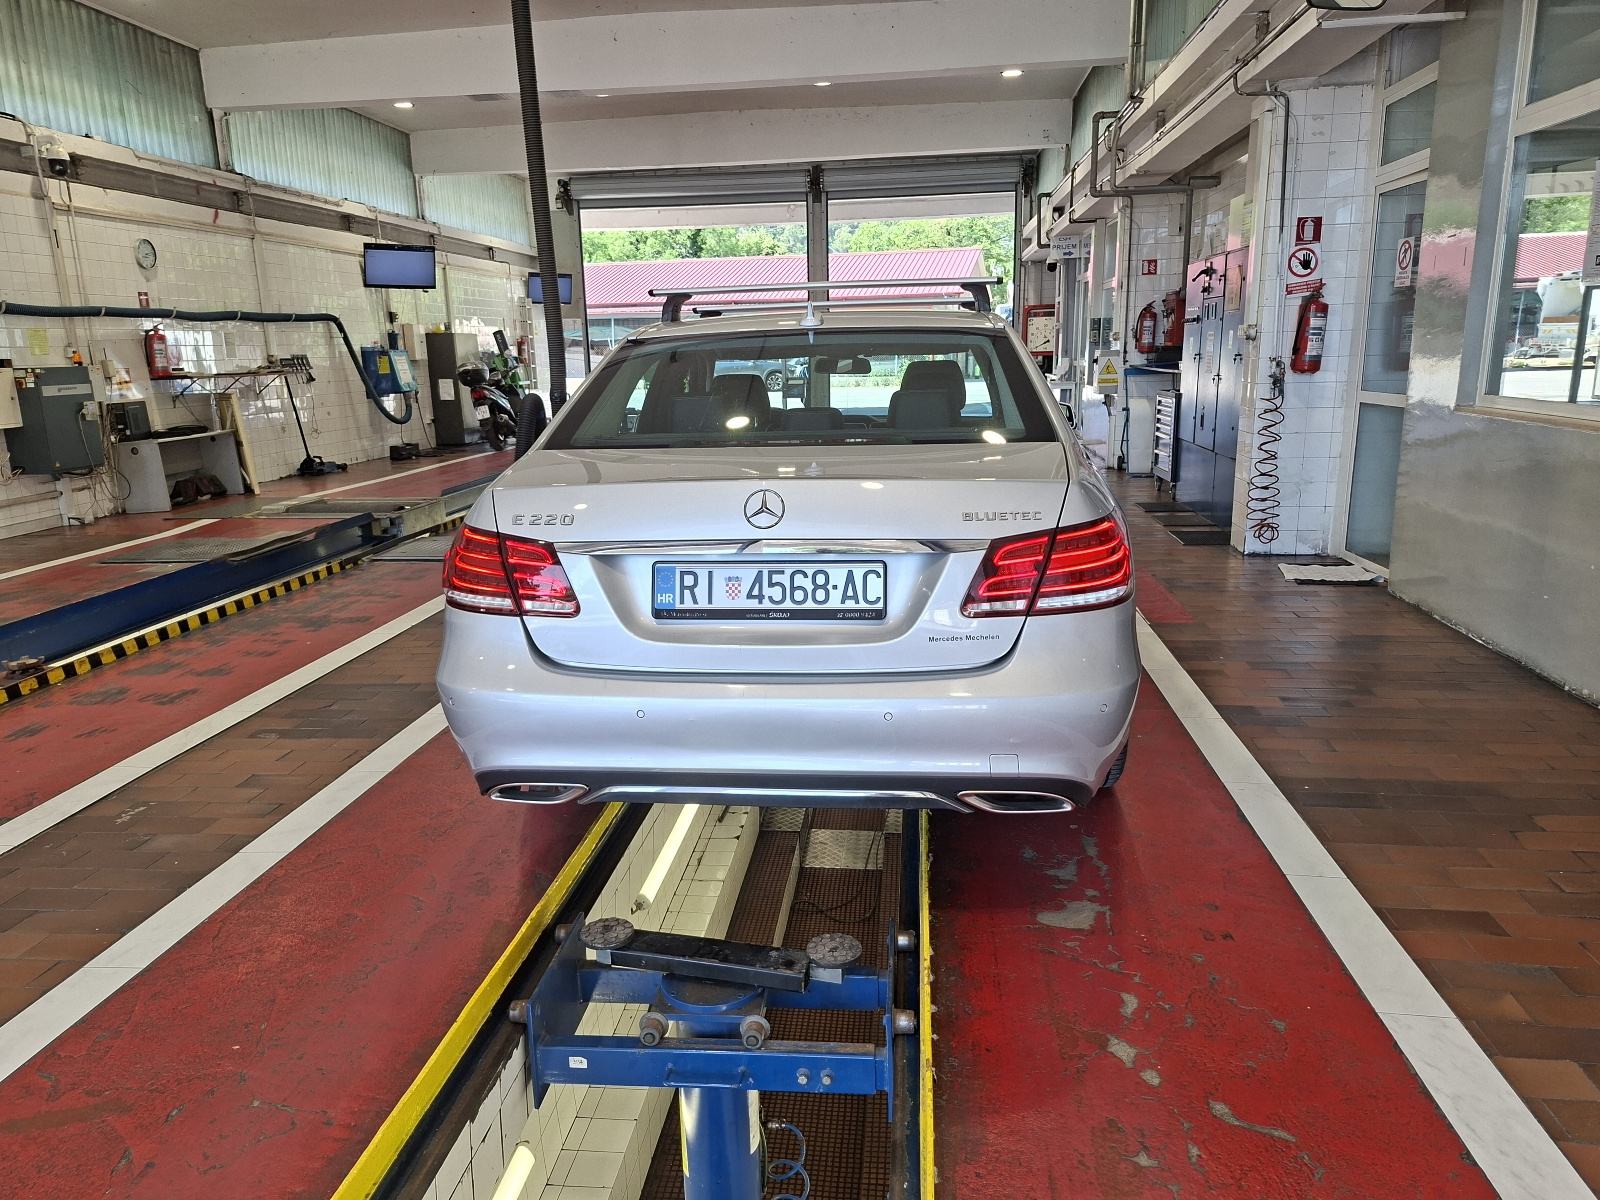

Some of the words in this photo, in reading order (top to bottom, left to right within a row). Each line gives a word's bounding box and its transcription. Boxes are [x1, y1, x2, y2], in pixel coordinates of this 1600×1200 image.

[511, 513, 525, 526] E
[528, 513, 575, 526] 220
[961, 511, 1043, 522] BLUETEC
[679, 570, 713, 606] RI
[657, 593, 674, 604] HR
[928, 635, 964, 643] Mercedes
[965, 633, 1000, 641] Mechelen
